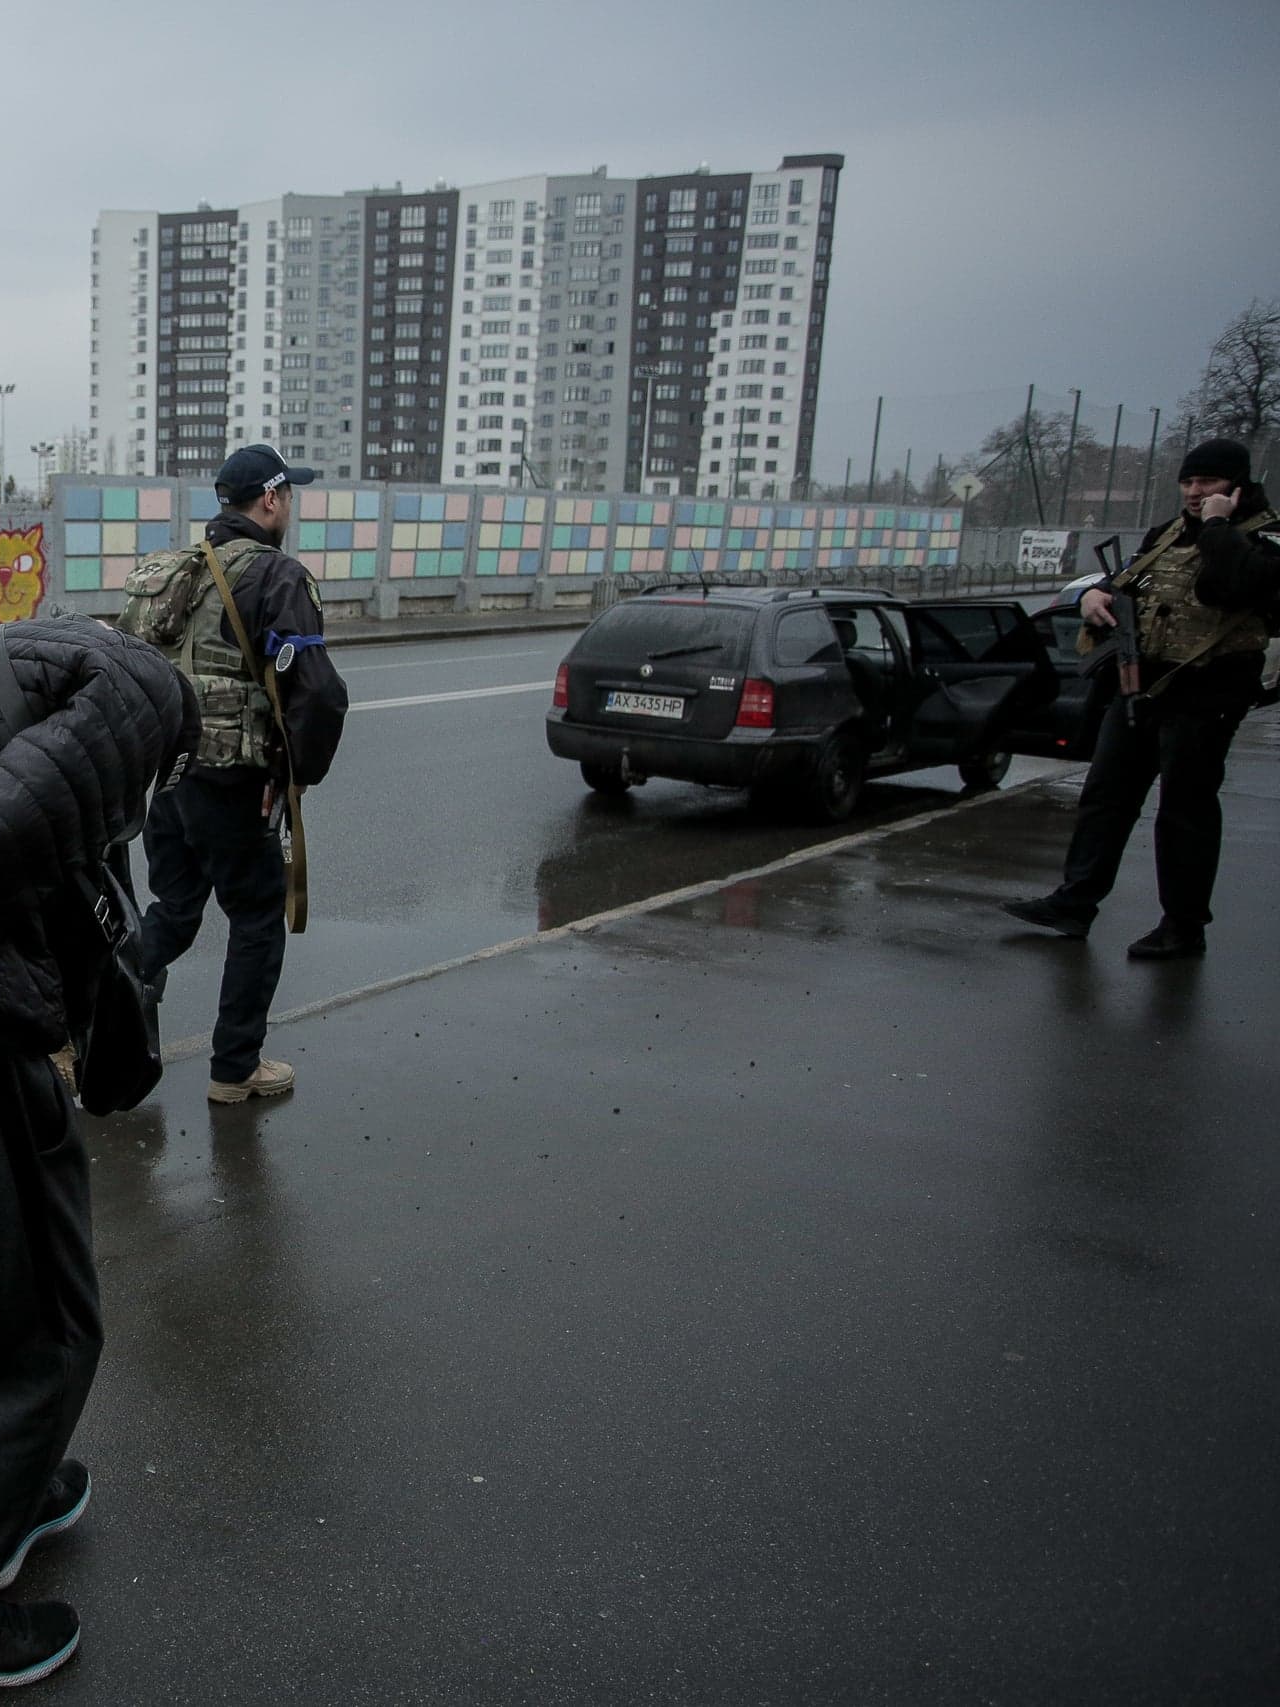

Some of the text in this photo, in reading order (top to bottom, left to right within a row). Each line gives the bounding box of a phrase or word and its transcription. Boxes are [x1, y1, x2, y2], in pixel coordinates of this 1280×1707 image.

[613, 694, 681, 713] AX 3435 HP
